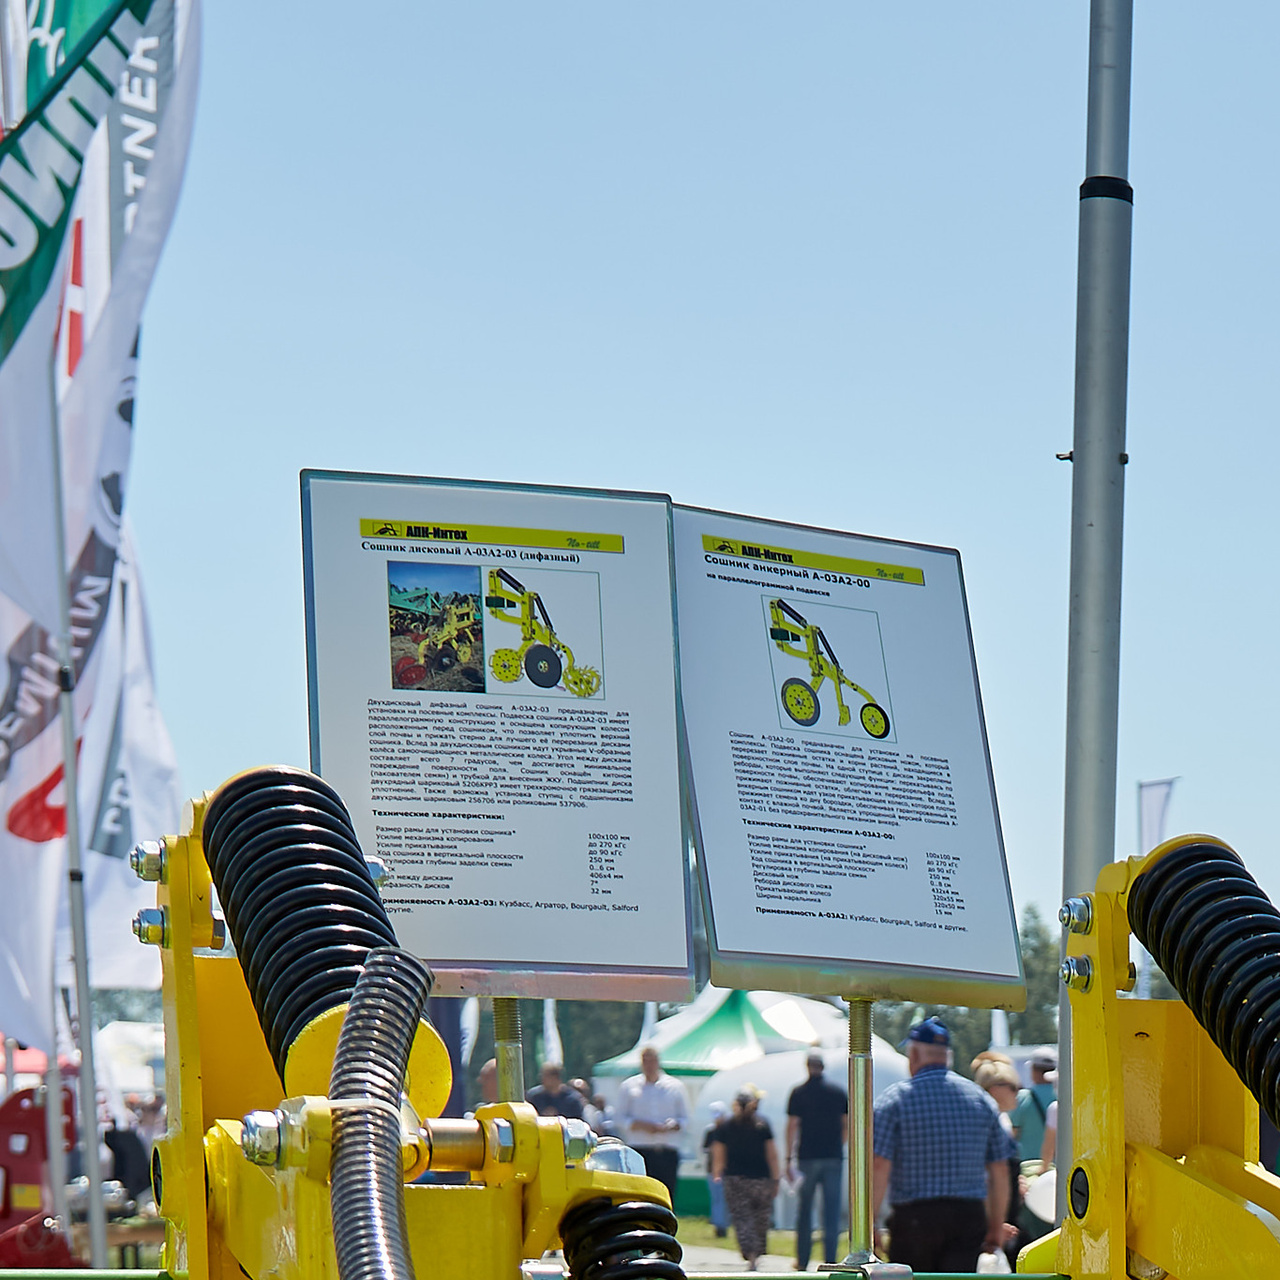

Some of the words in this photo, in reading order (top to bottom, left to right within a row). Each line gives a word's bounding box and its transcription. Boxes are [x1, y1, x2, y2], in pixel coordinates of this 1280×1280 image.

[361, 541, 406, 552] Сошник
[408, 544, 461, 555] дисковый
[519, 551, 579, 564] (дифазный)
[704, 554, 749, 569] Сошник
[752, 562, 809, 580] анкерный
[372, 809, 429, 818] Технические
[432, 812, 504, 820] характеристики:
[742, 818, 791, 829] Технические
[793, 824, 853, 835] характеристики
